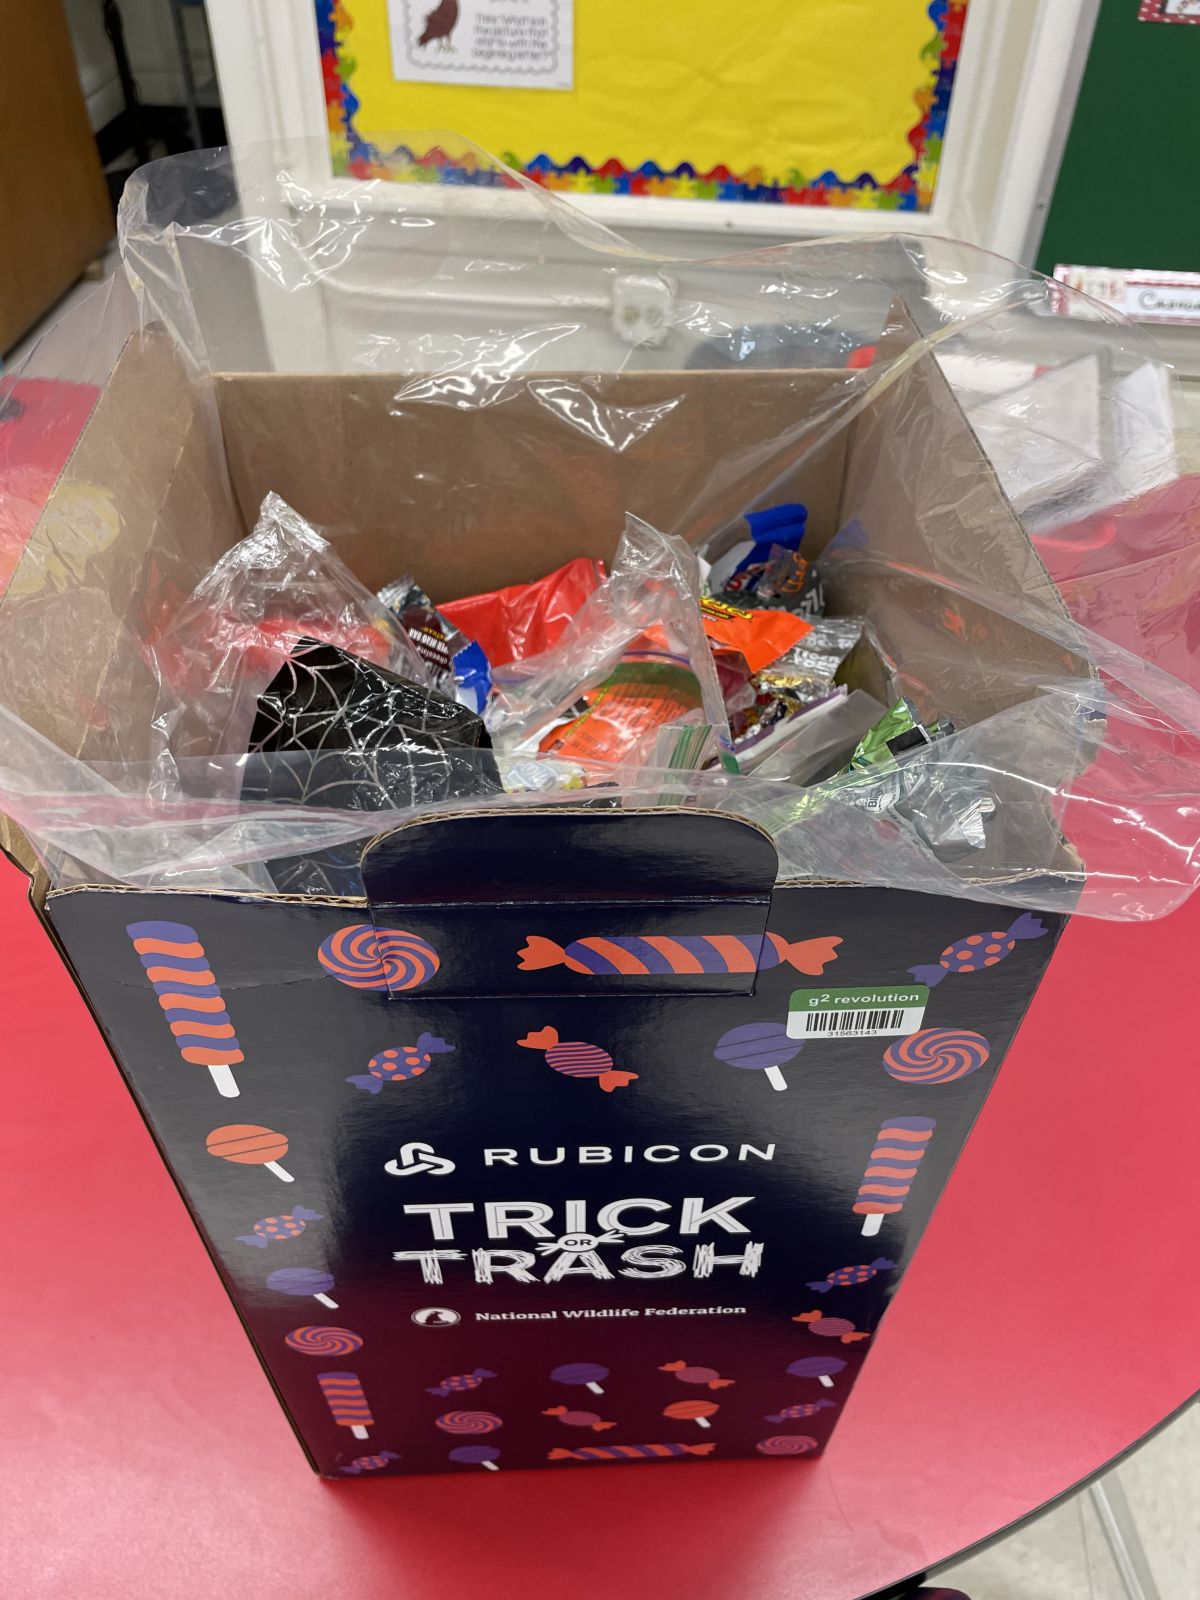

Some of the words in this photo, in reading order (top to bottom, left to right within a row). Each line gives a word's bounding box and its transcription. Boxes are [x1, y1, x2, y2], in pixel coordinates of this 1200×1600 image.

[834, 992, 919, 1004] revolution
[484, 1143, 777, 1166] RUBICON
[402, 1196, 755, 1240] TRICK
[564, 1238, 593, 1248] OR
[391, 1241, 765, 1285] TRASH
[475, 1310, 557, 1322] National
[562, 1307, 640, 1318] Wildlife
[644, 1304, 747, 1316] Federation
